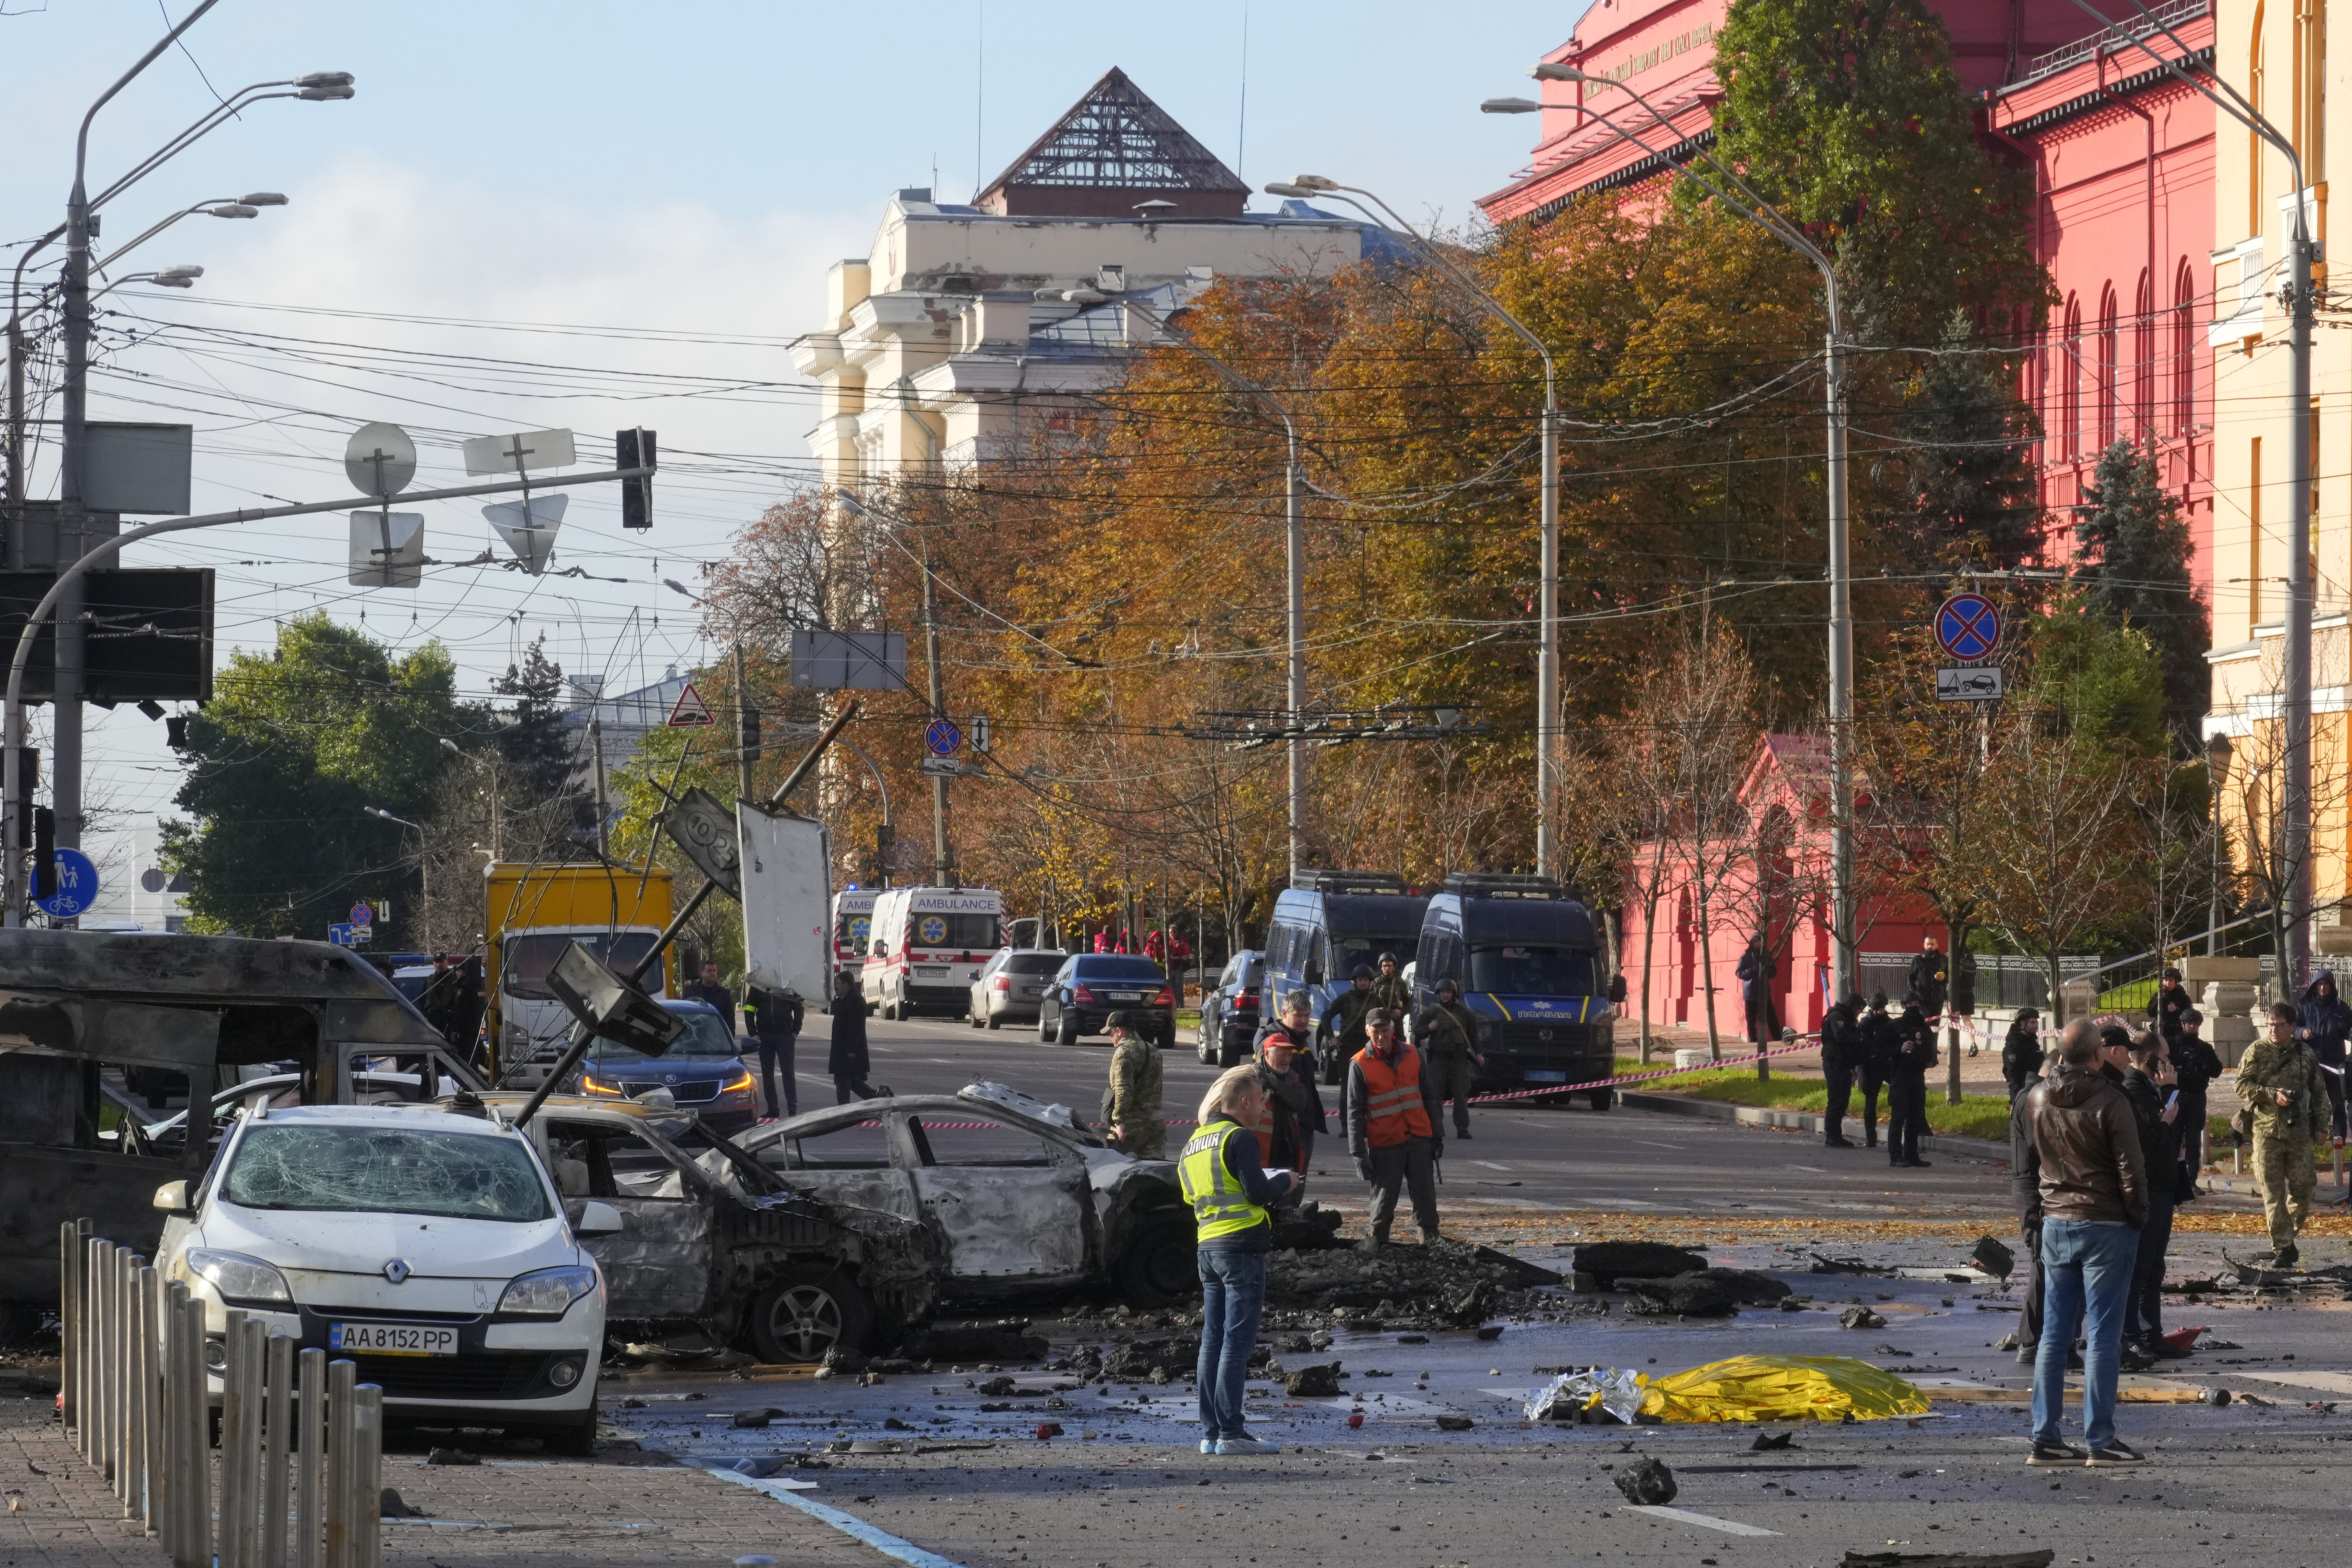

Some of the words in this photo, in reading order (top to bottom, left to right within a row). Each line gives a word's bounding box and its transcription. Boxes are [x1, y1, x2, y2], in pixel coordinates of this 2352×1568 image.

[1673, 32, 1690, 56] ТАРАСА
[691, 816, 709, 837] 10
[712, 836, 738, 864] 25
[918, 899, 995, 910] AMBULANCE
[343, 1328, 370, 1347] AA
[376, 1329, 419, 1348] 8152
[424, 1331, 452, 1349] PP
